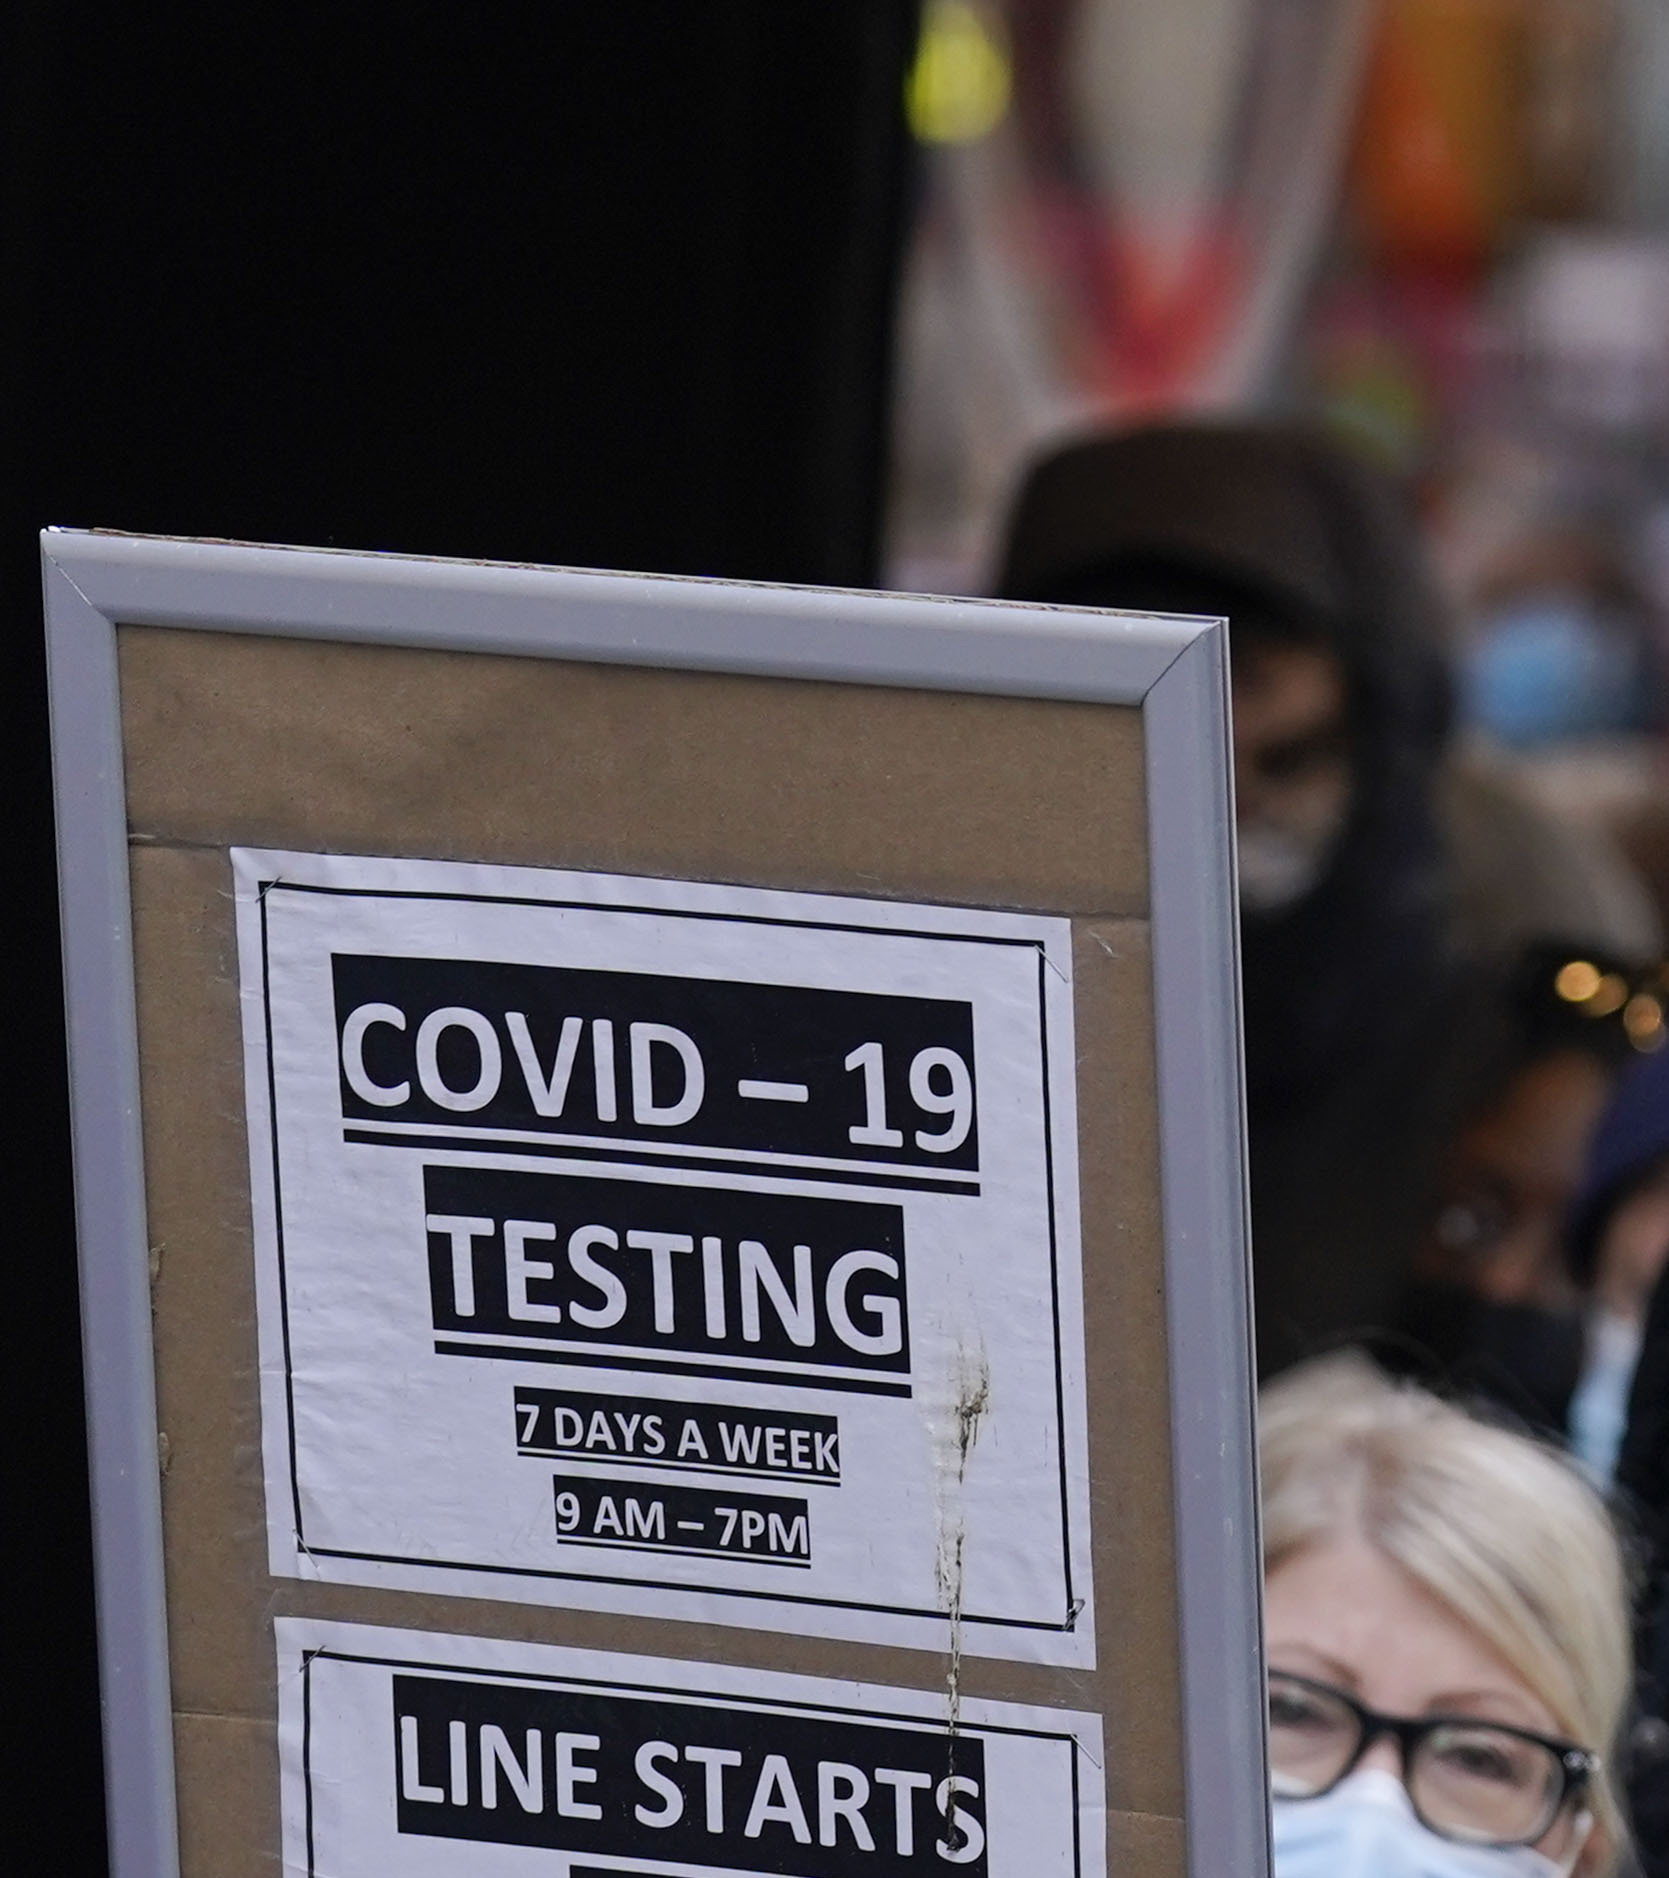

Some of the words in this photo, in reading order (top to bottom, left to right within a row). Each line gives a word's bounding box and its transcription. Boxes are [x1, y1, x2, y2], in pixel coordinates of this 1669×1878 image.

[342, 1002, 705, 1126] COVID
[844, 1042, 973, 1154] 19
[426, 1214, 902, 1356] TESTING
[516, 1404, 539, 1443] 7
[554, 1407, 666, 1455] DAYS
[677, 1419, 709, 1459] A
[718, 1421, 840, 1473] WEEK
[556, 1492, 581, 1531] 9
[593, 1496, 665, 1540] AM
[714, 1507, 809, 1555] 7PM
[400, 1715, 602, 1820] LINE
[634, 1740, 986, 1864] STARTS
